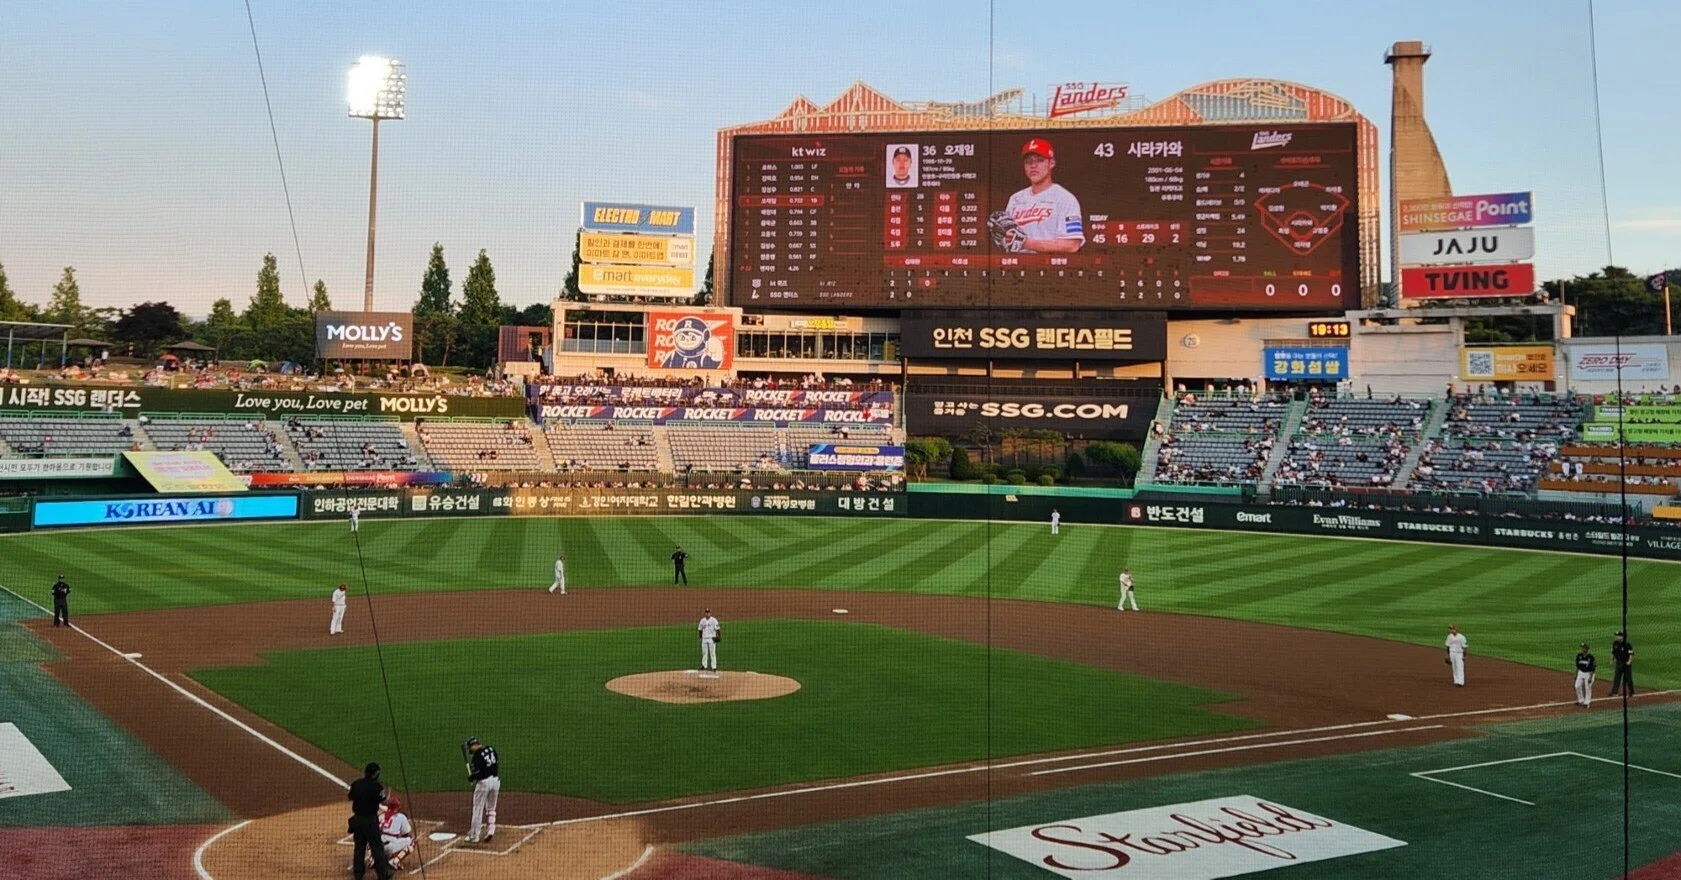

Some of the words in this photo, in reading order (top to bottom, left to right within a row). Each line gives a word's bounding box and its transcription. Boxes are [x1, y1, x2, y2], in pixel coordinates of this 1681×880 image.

[1066, 82, 1084, 90] SSG
[1049, 82, 1128, 118] Landers
[1251, 131, 1292, 150] Landers
[792, 147, 803, 157] kt
[805, 147, 826, 157] wiz
[923, 145, 936, 156] 36
[944, 144, 975, 156] 오재일
[1094, 142, 1114, 157] 43
[1128, 141, 1183, 158] 시라카와
[593, 207, 639, 224] ELECTRO
[648, 210, 681, 226] MART
[1476, 200, 1528, 220] Point
[1403, 210, 1473, 225] SHINSEGAE
[587, 238, 610, 248] 할인과
[612, 239, 635, 249] 결제를
[1092, 234, 1106, 243] 45
[1116, 234, 1128, 243] 16
[1142, 233, 1155, 243] 29
[1172, 234, 1179, 243] 2
[1433, 236, 1498, 255] JAJU
[586, 249, 610, 258] 이마트
[593, 269, 633, 282] emart
[1425, 270, 1509, 291] TVING
[1265, 284, 1275, 296] 0
[1298, 284, 1308, 296] 0
[1331, 284, 1341, 296] 0
[326, 322, 402, 341] MOLLY'S
[1311, 323, 1348, 336] 19:13
[933, 328, 972, 348] 인천
[979, 328, 1029, 348] SSG
[1036, 328, 1133, 350] 랜더스필드
[1579, 356, 1607, 365] ZERO
[1609, 356, 1632, 365] DAY
[1274, 361, 1340, 375] 강화섬쌀
[9, 389, 49, 406] 시작!
[54, 389, 86, 406] SSG
[90, 391, 141, 407] 랜더스
[621, 387, 683, 399] 로케트배터리
[746, 390, 792, 400] ROCKET
[805, 390, 853, 402] ROCKET
[235, 394, 272, 408] Love
[274, 396, 304, 410] you,
[306, 395, 342, 410] Love
[344, 397, 369, 411] pet
[380, 395, 448, 413] MOLLY'S
[541, 405, 592, 418] ROCKET
[612, 406, 663, 419] ROCKET
[684, 408, 735, 420] ROCKET
[754, 409, 806, 421] ROCKET
[980, 402, 1129, 419] SSG.COM
[20, 463, 40, 472] 모두가
[43, 462, 76, 472] 한마음으로
[79, 462, 112, 472] 기원합니다
[314, 496, 399, 512] 인하공업전문대학
[429, 495, 480, 510] 유승건설
[591, 495, 658, 508] 경인여자대학교
[667, 495, 736, 509] 한길안과병원
[763, 499, 816, 510] 국제성모병원
[838, 497, 895, 511] 대방건설
[105, 501, 190, 519] KOREAN
[1146, 506, 1204, 523] 반도건설
[1236, 512, 1272, 523] emart
[1313, 514, 1338, 525] Evan
[1338, 515, 1381, 527] Williams
[1397, 521, 1455, 532] STARBUCKS
[1493, 528, 1552, 539] STARBUCKS
[484, 754, 497, 767] 36
[1031, 803, 1333, 871] Starfield
